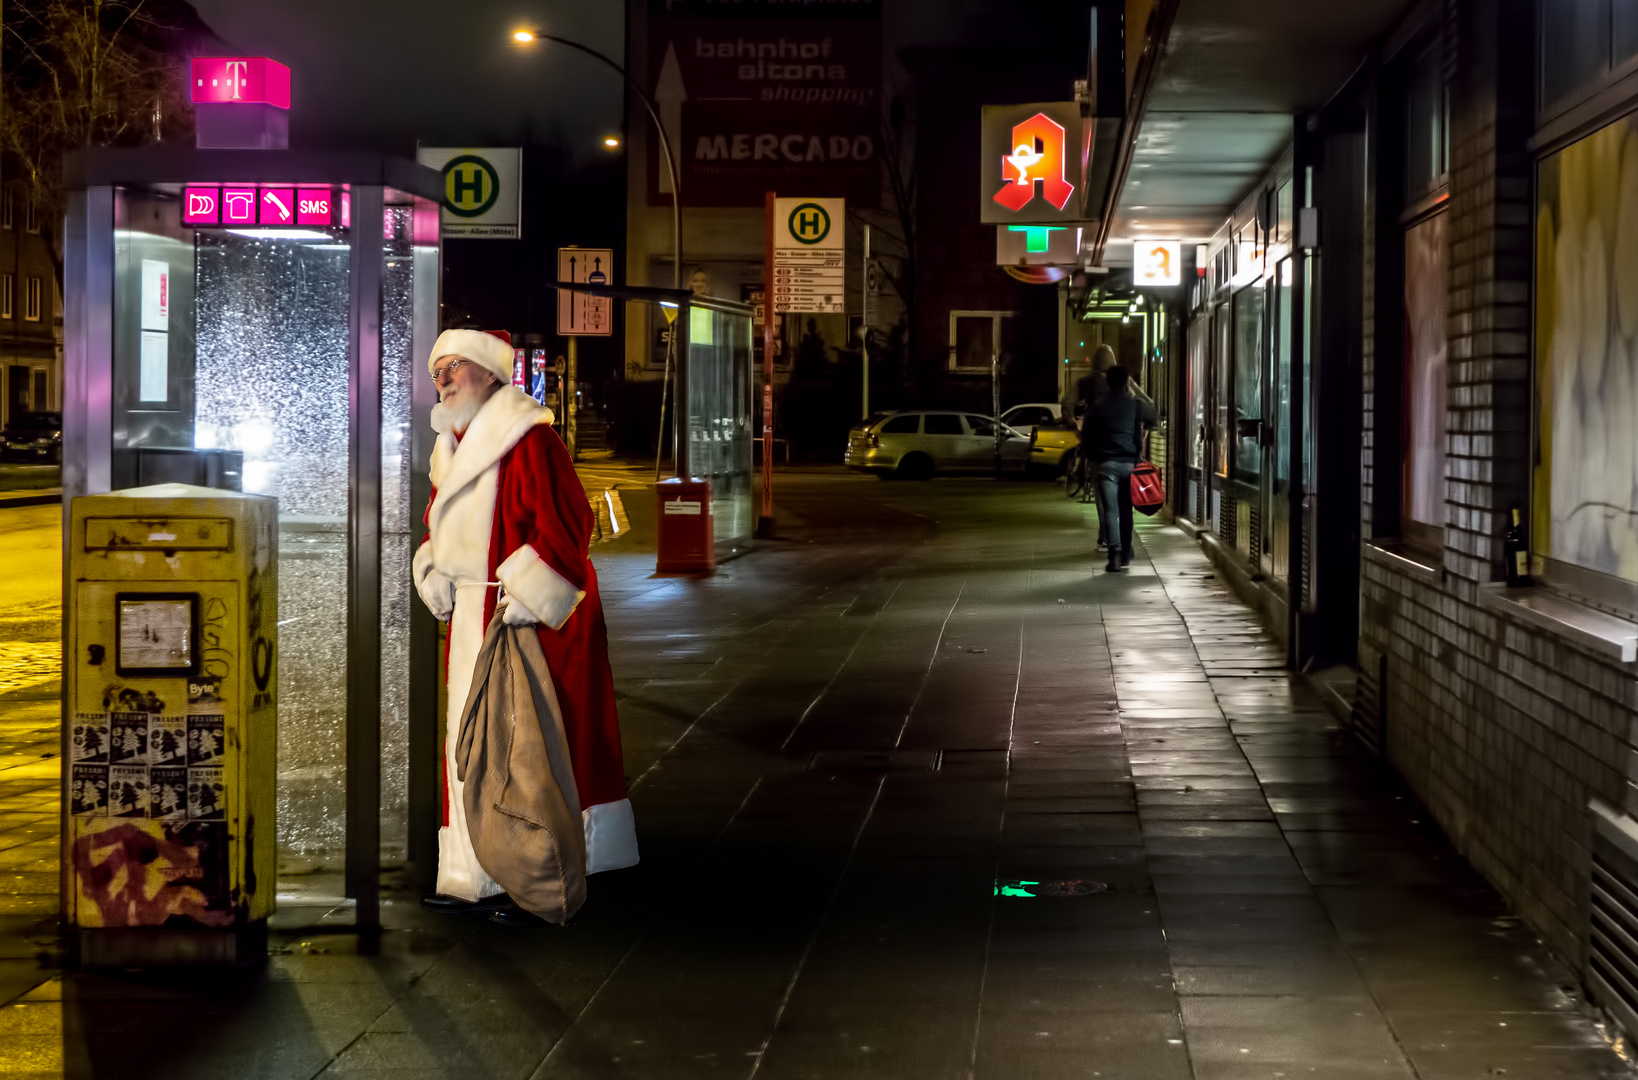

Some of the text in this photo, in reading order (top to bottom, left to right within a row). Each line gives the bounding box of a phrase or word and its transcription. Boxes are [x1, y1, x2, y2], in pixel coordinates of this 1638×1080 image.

[695, 36, 833, 59] bahnhof
[738, 59, 846, 80] altona
[761, 83, 874, 106] shopping
[695, 133, 875, 163] MERCADO
[300, 200, 328, 214] SMS
